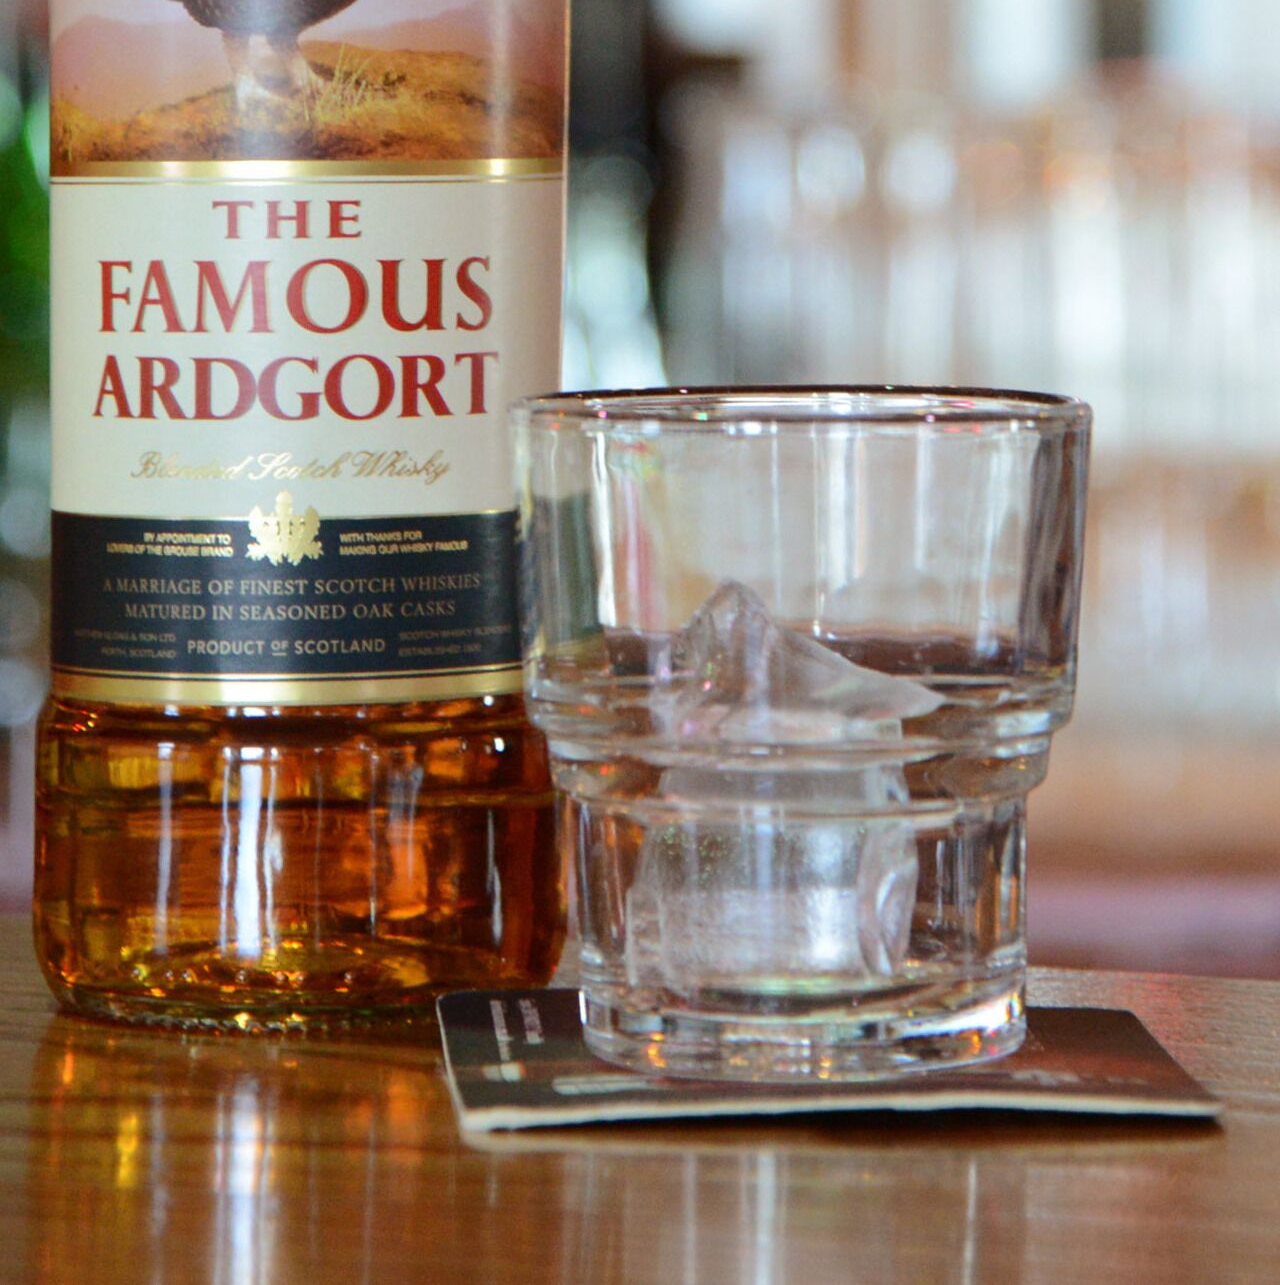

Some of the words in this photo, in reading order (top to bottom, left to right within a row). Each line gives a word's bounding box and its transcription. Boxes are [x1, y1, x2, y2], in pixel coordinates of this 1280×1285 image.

[212, 200, 362, 240] THE
[98, 256, 492, 335] FAMOUS
[92, 352, 499, 421] ARDGORT
[130, 451, 253, 480] Blended
[248, 451, 351, 481] Scotch
[350, 449, 451, 485] Whisky
[143, 532, 156, 543] BY
[157, 532, 214, 544] APPOINTMENT
[215, 533, 232, 545] TO
[339, 532, 365, 543] WITH
[365, 531, 402, 542] THANKS
[403, 530, 423, 541] FOR
[146, 544, 162, 556] THE
[339, 544, 377, 556] MAKING
[378, 543, 399, 555] OUR
[400, 542, 434, 554] WHISKY
[103, 579, 113, 593] A
[117, 579, 201, 595] MARRIAGE
[208, 579, 234, 595] OF
[240, 579, 308, 595] FINEST
[314, 577, 396, 595] SCOTCH
[401, 573, 482, 592] WHISKIES
[125, 603, 206, 620] MATURED
[212, 604, 234, 621] IN
[240, 604, 346, 621] SEASONED
[353, 602, 394, 619] OAK
[400, 600, 456, 618] CASKS
[187, 640, 265, 655] PRODUCT
[271, 640, 288, 656] OF
[294, 639, 386, 655] SCOTLAND
